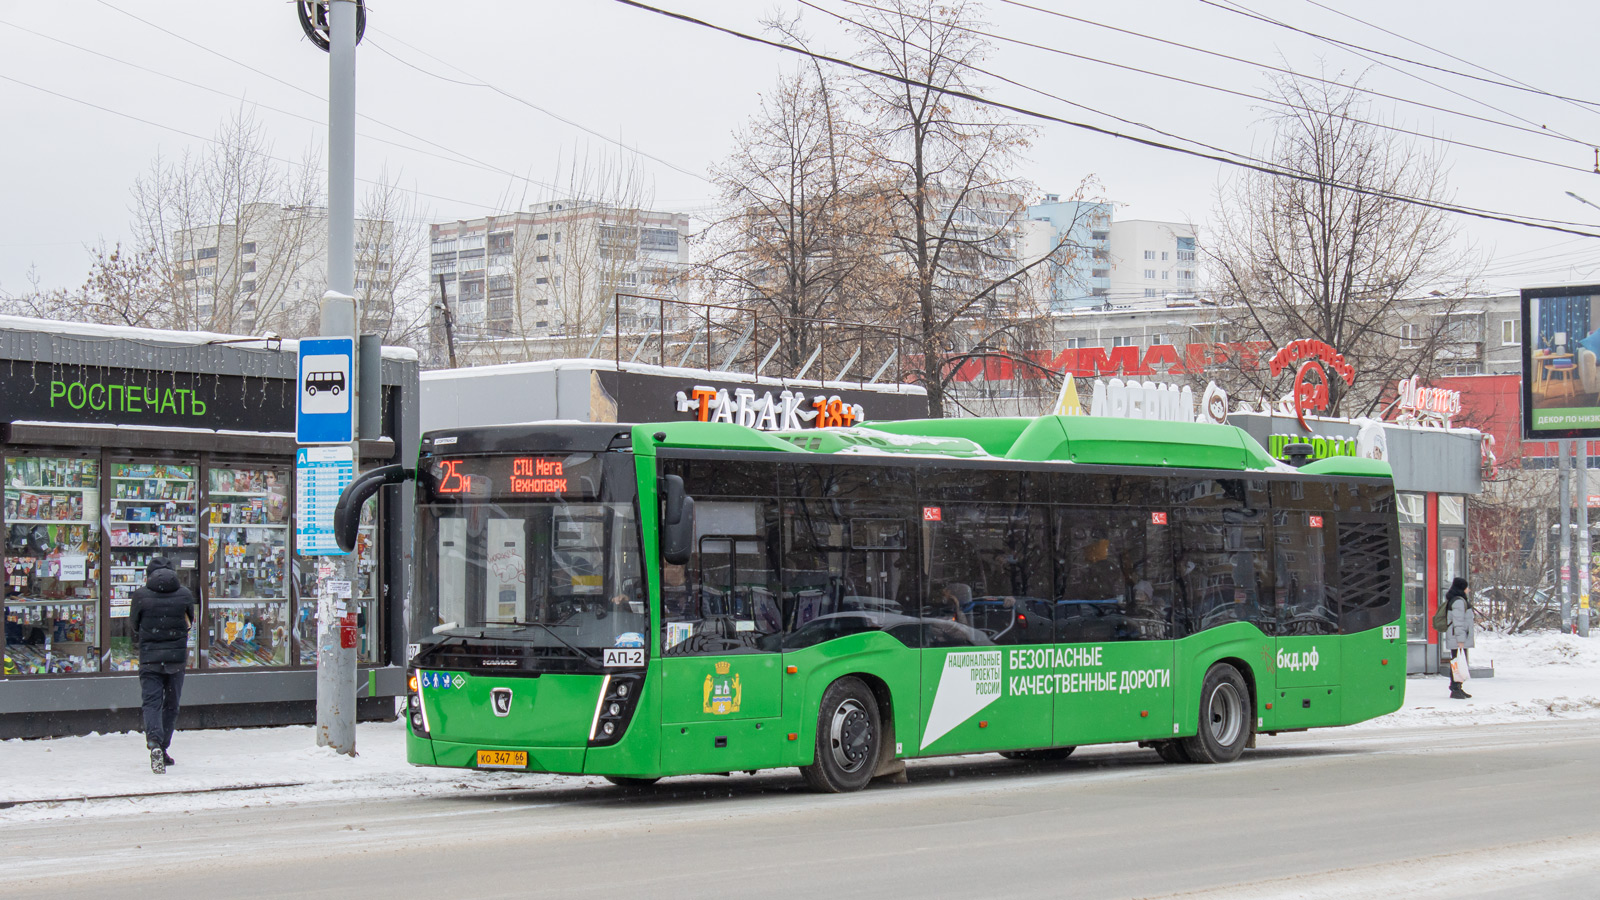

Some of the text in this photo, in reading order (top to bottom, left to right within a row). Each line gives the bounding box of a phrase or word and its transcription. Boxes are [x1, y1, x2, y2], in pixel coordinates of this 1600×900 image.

[1269, 338, 1355, 387] ВОСТОЧНАЯ
[50, 381, 207, 416] РОСПЕЧАТЬ
[1300, 382, 1329, 411] 24
[692, 386, 856, 431] ТАБАК 18+
[1537, 416, 1565, 425] ДЕКОР
[1565, 415, 1577, 423] ПО
[513, 457, 533, 476] СТЦ
[535, 457, 563, 476] Мега
[509, 475, 567, 493] Технопарк
[1385, 627, 1396, 638] 337
[606, 651, 642, 664] АП-2
[948, 653, 1001, 668] НАЦИОНАЛЬНЫЕ
[1009, 646, 1104, 670] БЕЗОПАСНЫЕ
[1276, 646, 1320, 672] бкд.рф
[970, 667, 1001, 681] ПРОЕКТЫ
[1009, 668, 1171, 697] КАЧЕСТВЕННЫЕ ДОРОГИ
[975, 681, 1001, 696] РОССИИ
[494, 752, 511, 764] 347
[515, 752, 525, 761] 66
